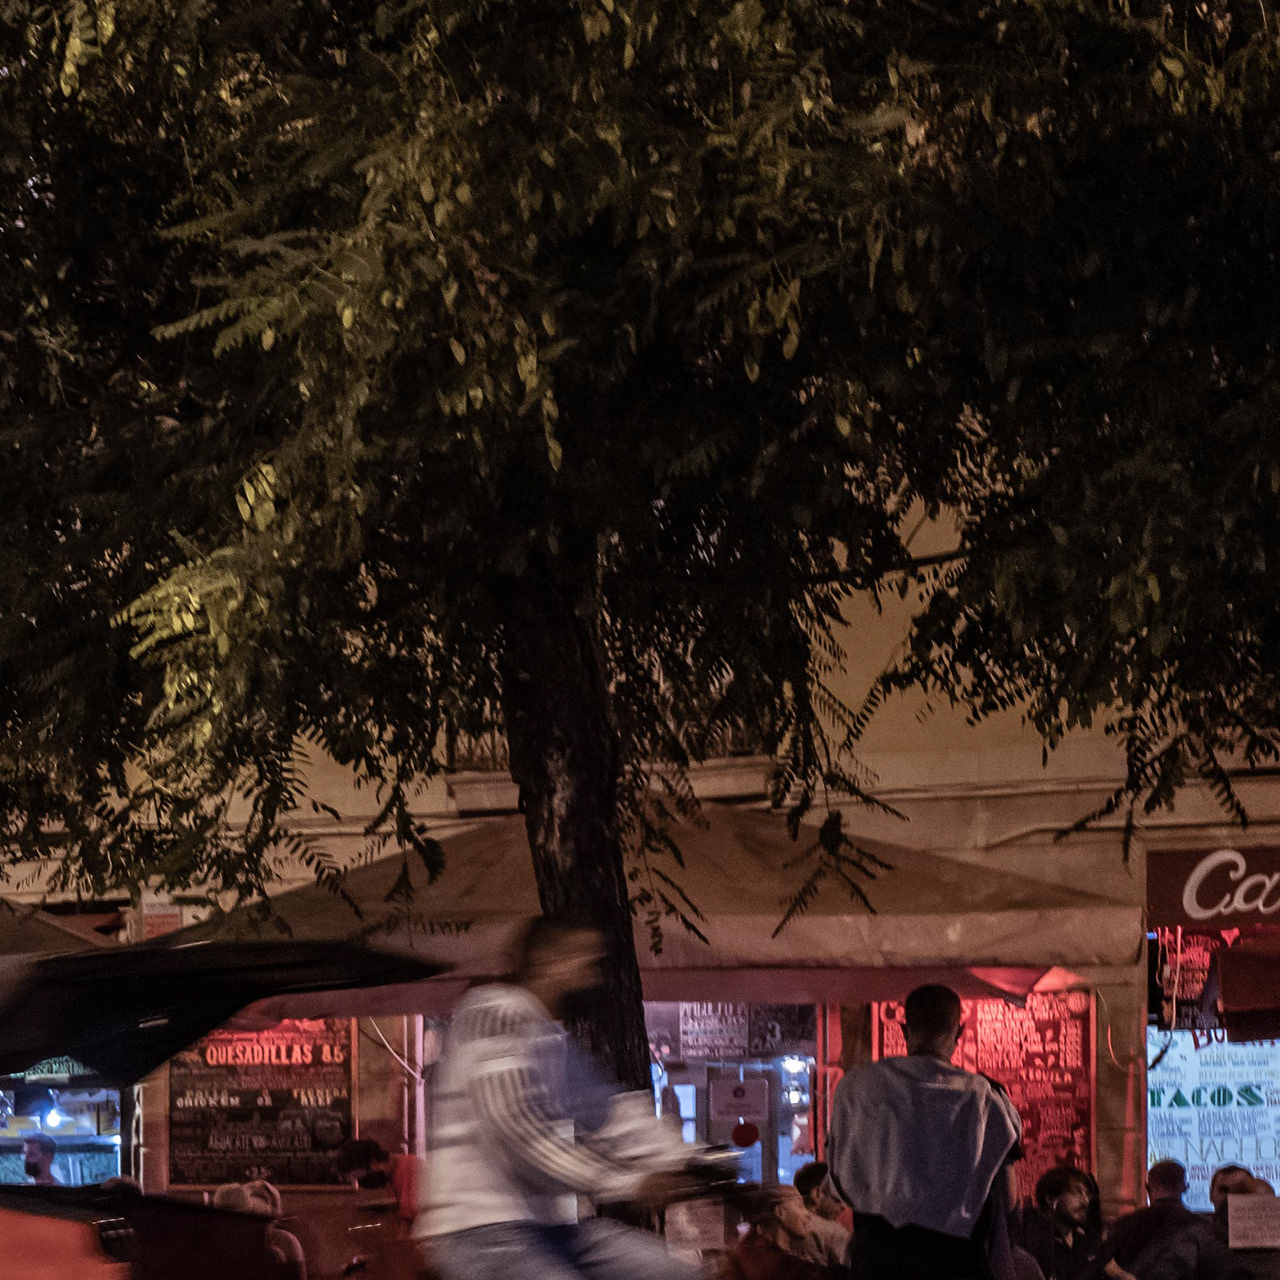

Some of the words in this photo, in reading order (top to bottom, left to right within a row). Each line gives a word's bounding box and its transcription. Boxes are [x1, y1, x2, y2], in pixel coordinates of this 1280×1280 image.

[206, 1044, 313, 1065] QUESADILLAS
[1149, 1086, 1266, 1108] TACOS
[1184, 1136, 1280, 1163] NACHO
